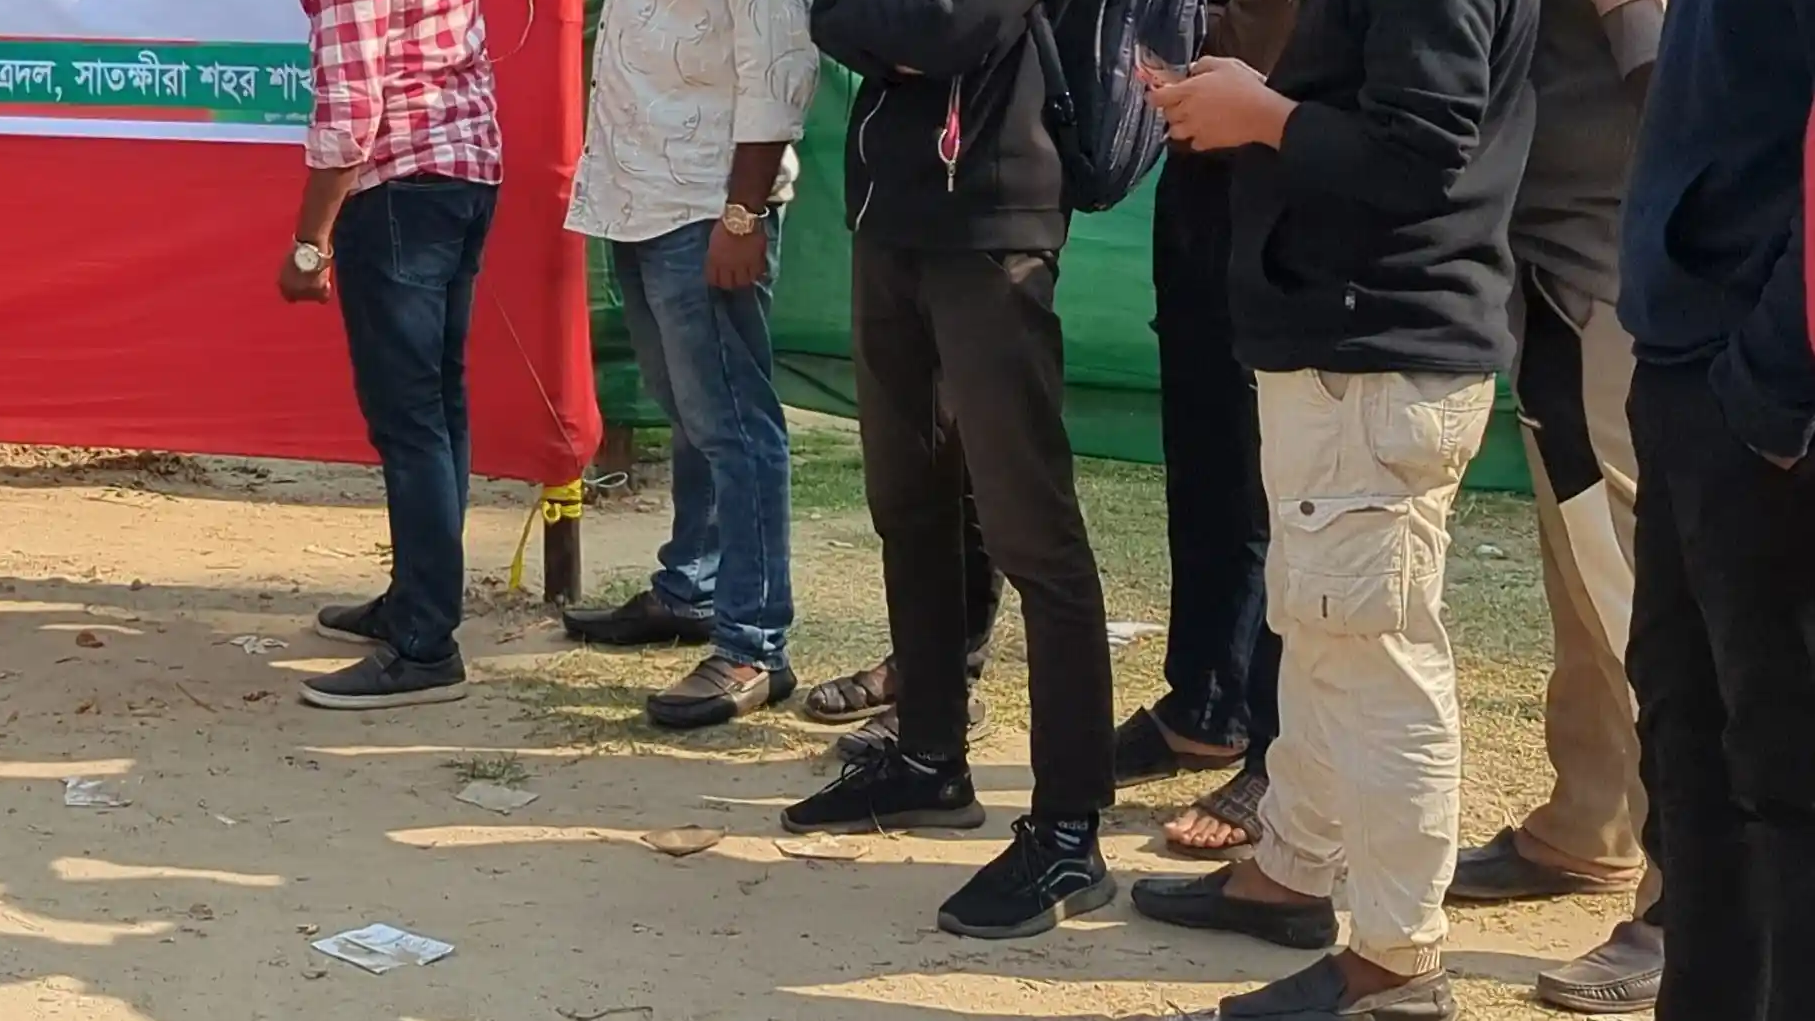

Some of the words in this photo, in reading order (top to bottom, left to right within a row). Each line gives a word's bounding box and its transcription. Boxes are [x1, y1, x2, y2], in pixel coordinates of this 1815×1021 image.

[72, 49, 190, 98] সাতক্ষীরা
[196, 61, 260, 105] শহর
[265, 62, 316, 103] শাখ
